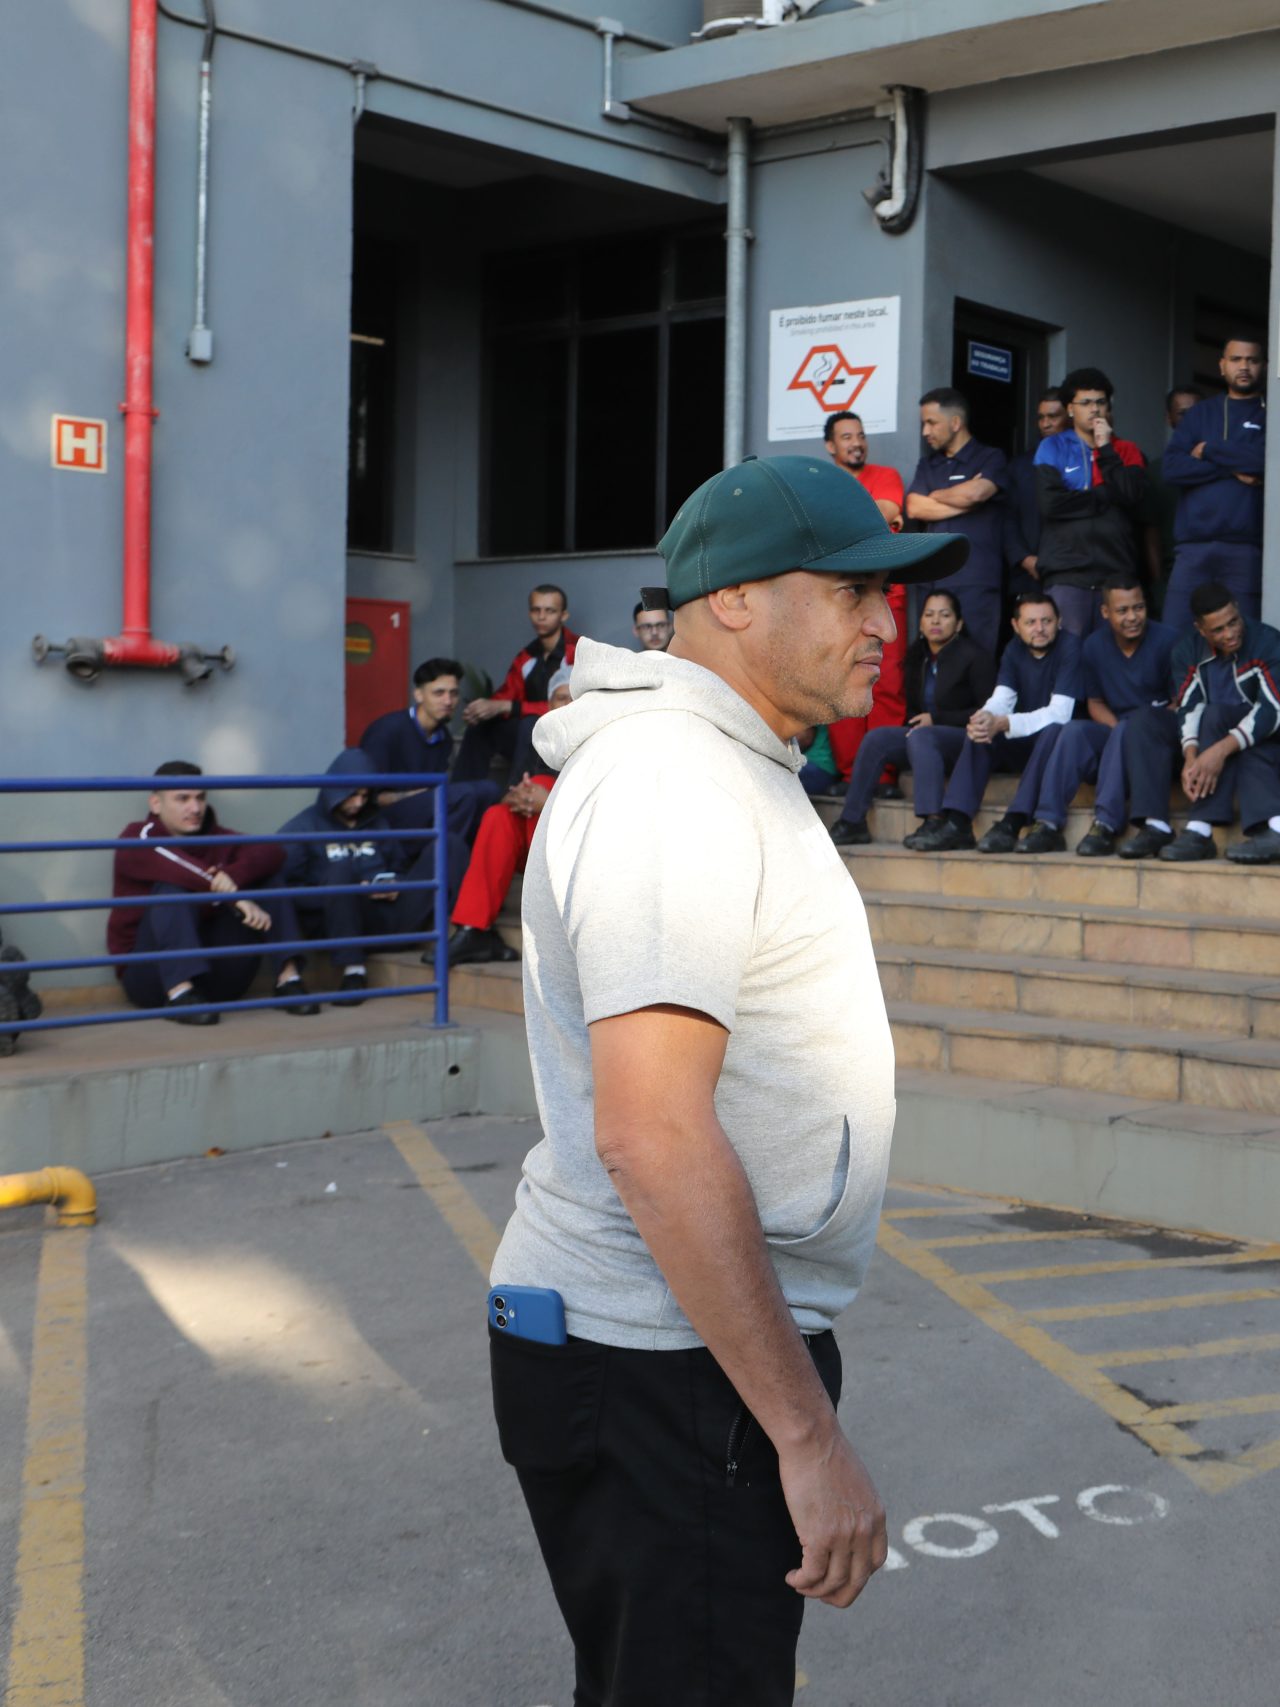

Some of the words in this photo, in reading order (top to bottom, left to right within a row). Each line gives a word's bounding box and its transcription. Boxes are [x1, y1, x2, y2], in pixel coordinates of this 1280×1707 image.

[779, 314, 785, 327] É
[786, 314, 816, 327] proibido
[818, 312, 841, 322] fumar
[844, 309, 865, 320] neste
[61, 424, 98, 465] H
[390, 612, 401, 629] 1
[884, 1483, 1171, 1572] OTO
